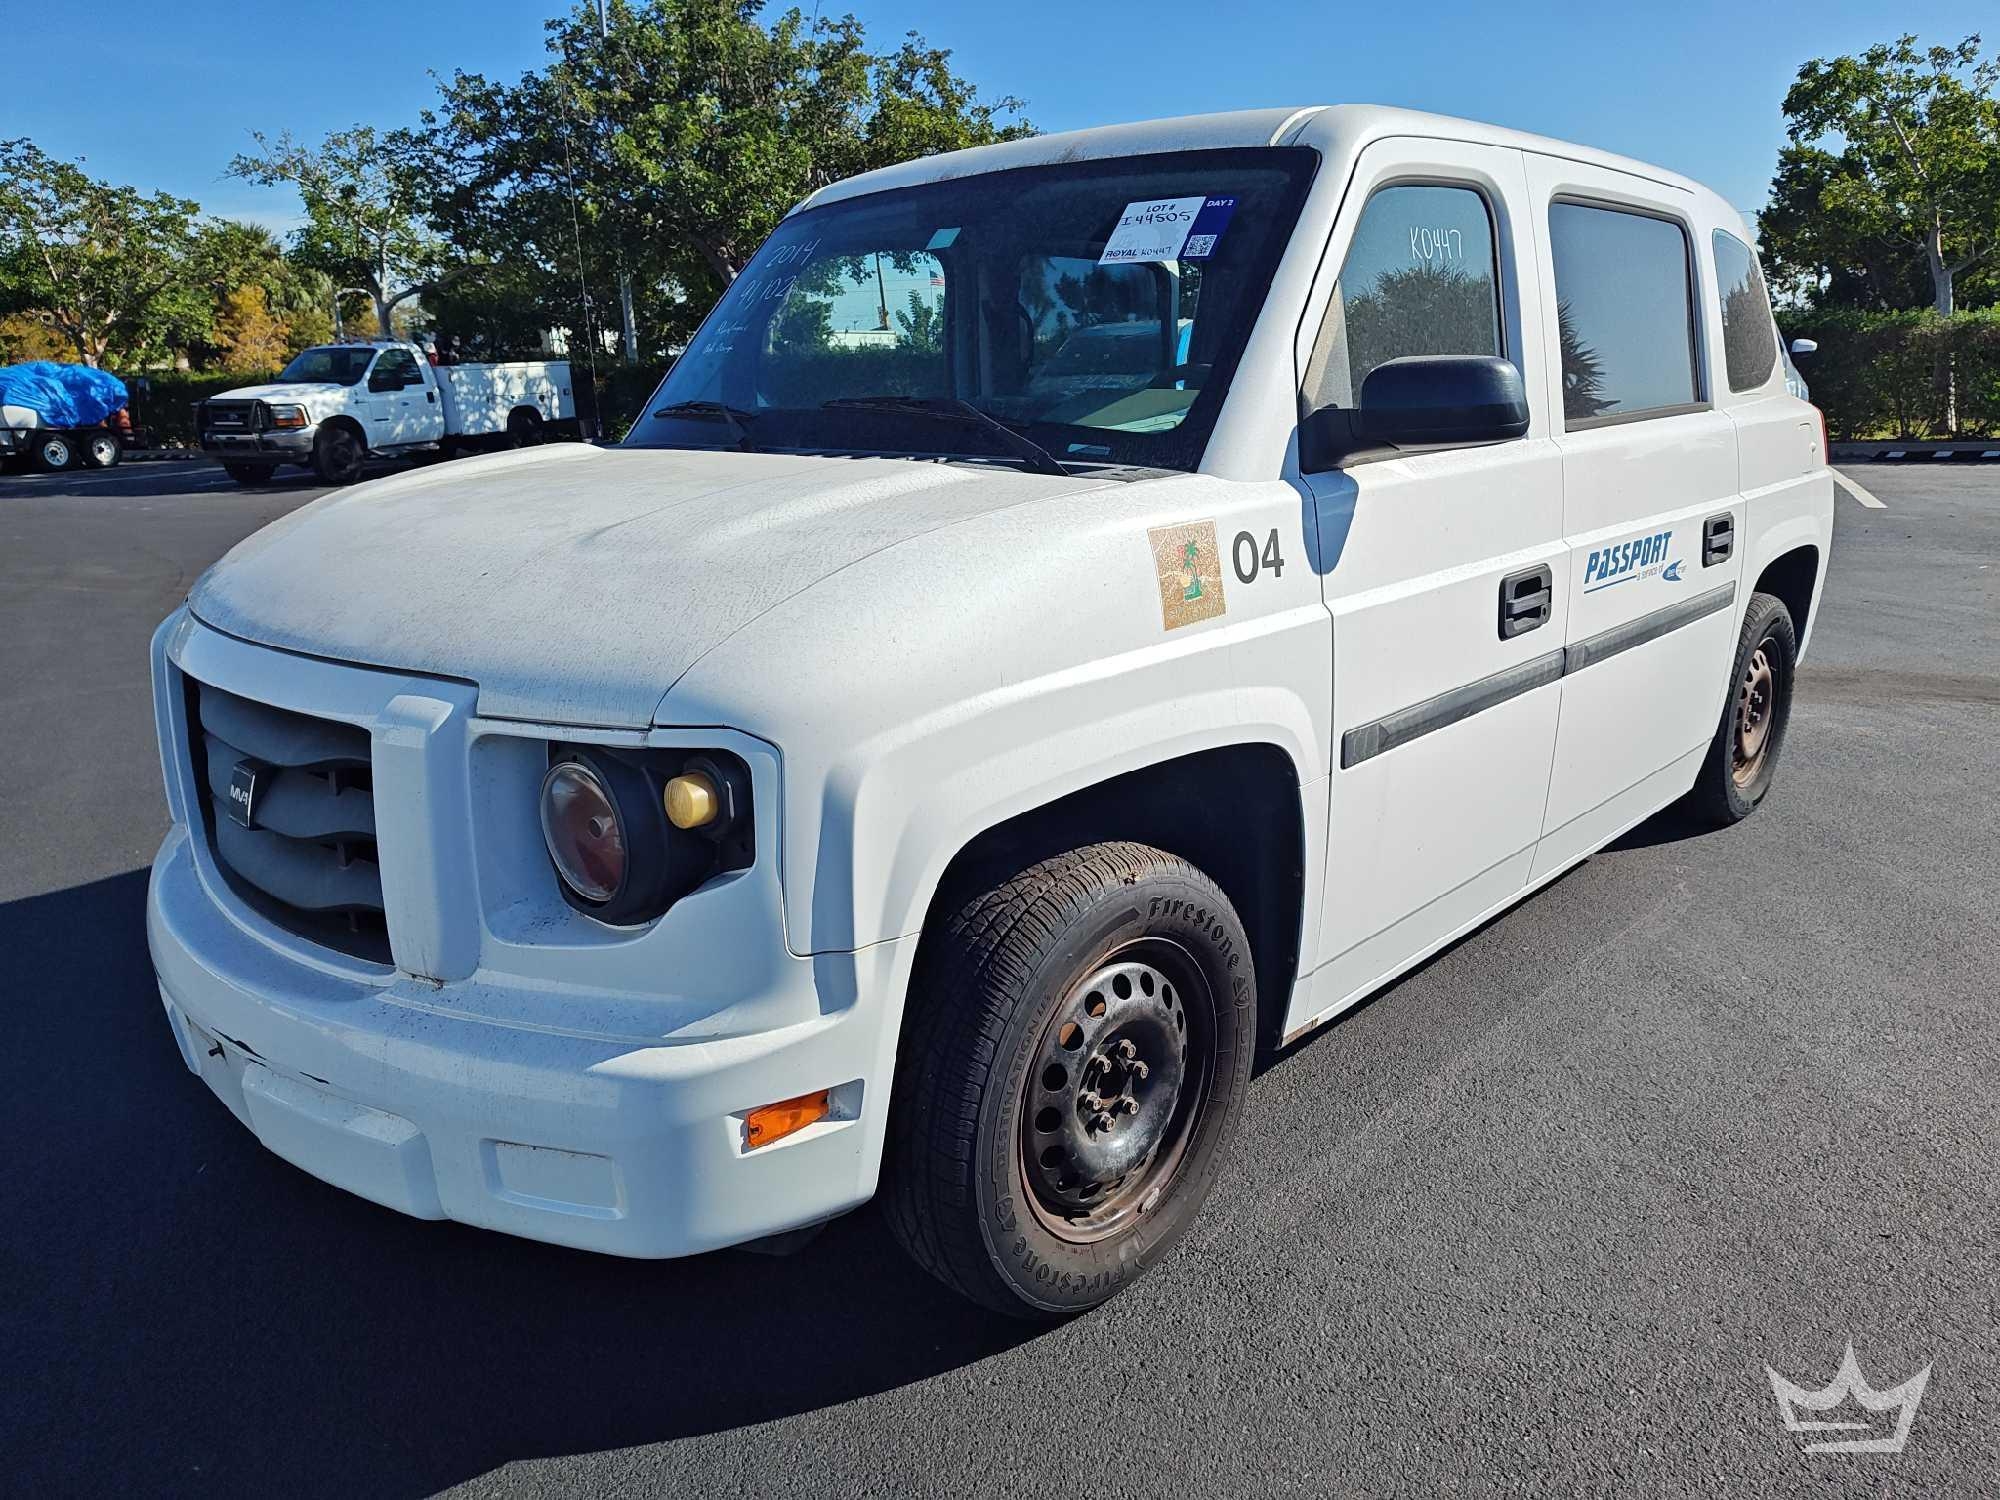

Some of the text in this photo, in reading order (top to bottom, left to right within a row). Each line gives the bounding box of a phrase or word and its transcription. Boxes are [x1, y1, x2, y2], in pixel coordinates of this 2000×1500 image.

[1146, 203, 1177, 213] LOT #
[1206, 199, 1228, 207] DAY
[765, 238, 822, 269] 2014
[1105, 249, 1138, 258] ROYAL
[1232, 528, 1285, 585] 04
[1583, 530, 1673, 585] PASSPORT
[1146, 895, 1240, 971] Firestone
